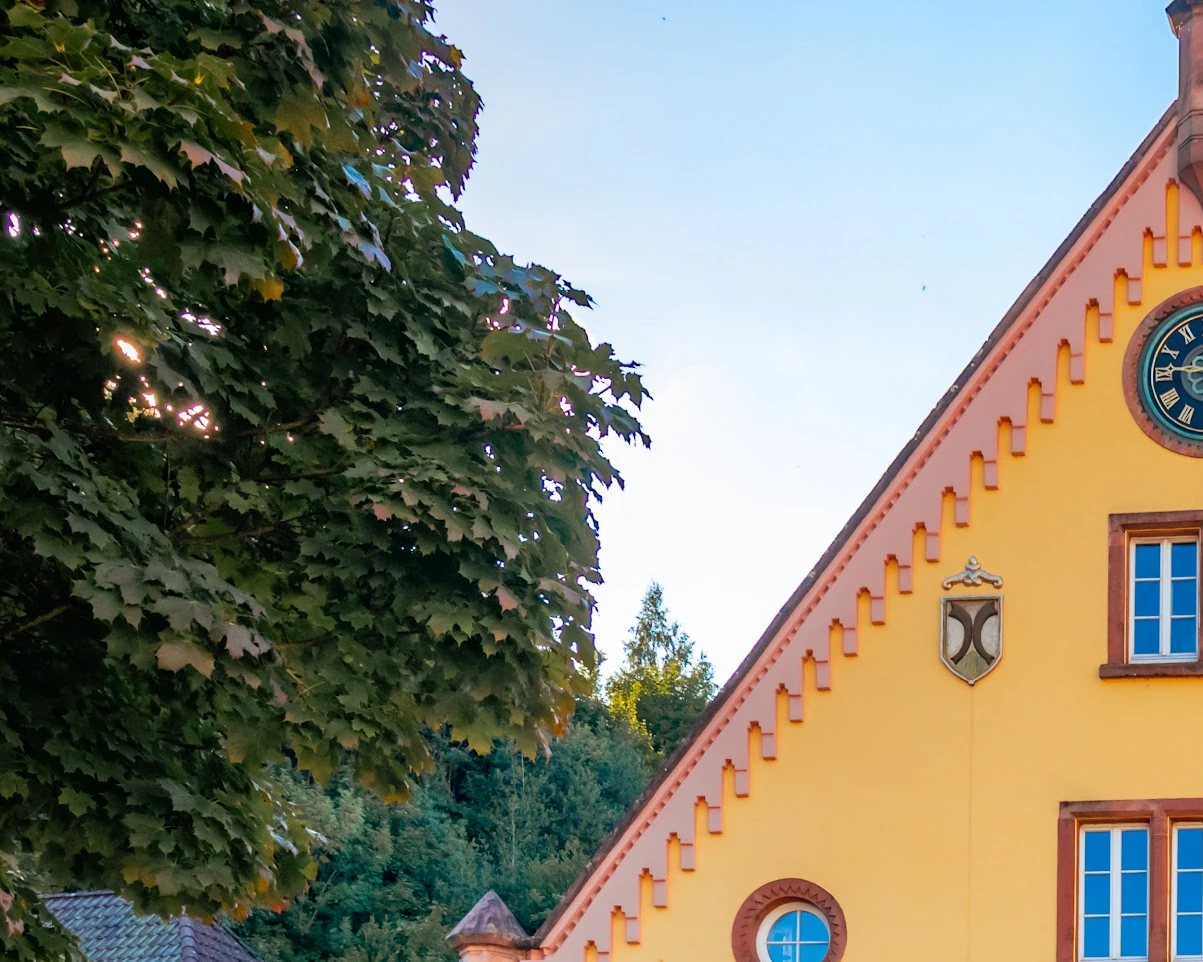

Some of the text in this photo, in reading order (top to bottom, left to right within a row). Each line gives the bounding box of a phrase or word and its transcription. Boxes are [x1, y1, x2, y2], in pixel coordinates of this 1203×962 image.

[1178, 324, 1196, 345] XI
[1161, 344, 1179, 360] X
[1159, 387, 1180, 410] VIII
[1178, 403, 1194, 425] VII
